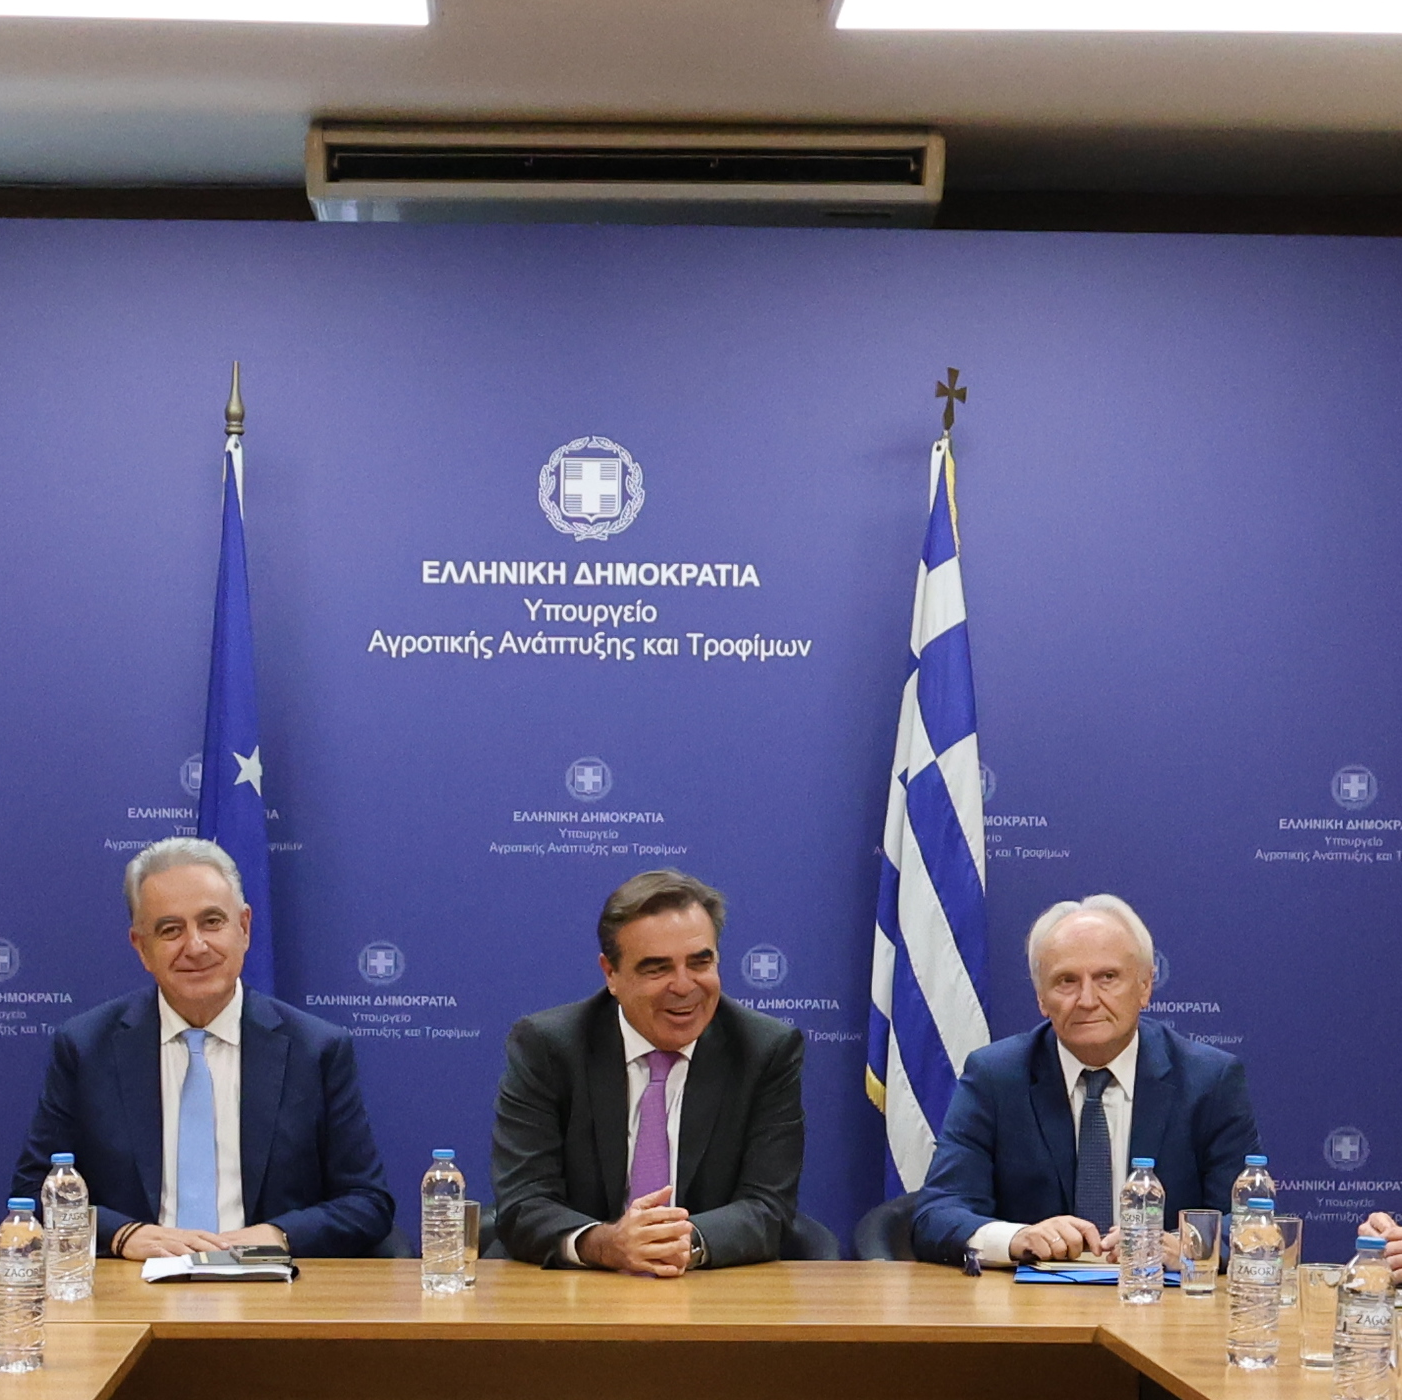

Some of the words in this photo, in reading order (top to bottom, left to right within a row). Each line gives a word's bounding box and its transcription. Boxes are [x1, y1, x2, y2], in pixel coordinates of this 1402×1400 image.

[422, 561, 566, 584] ΕΛΛΗΝΙΚΗ
[574, 563, 760, 587] ΔΗΜΟΚΡΑΤΙΑ
[524, 598, 657, 627] Υπουργείο
[368, 630, 493, 658] Αγροτικής
[499, 631, 635, 660] Ανάπτυξης
[643, 637, 678, 656] και
[686, 632, 812, 661] Τροφίμων
[127, 807, 193, 819] ΕΛΛΗΝΙΚΗ
[513, 810, 578, 823] ΕΛΛΗΝΙΚΗ
[581, 811, 664, 823] ΔΗΜΟΚΡΑΤΙΑ
[984, 815, 1048, 827] ΜΟΚΡΑΤΙΑ
[1279, 818, 1343, 830] ΕΛΛΗΝΙΚΗ
[558, 828, 619, 840] Υπουργείο
[1324, 835, 1383, 848] Υπουργείο
[489, 842, 545, 855] Αγροτικής
[547, 842, 609, 856] Ανάπτυξης
[612, 845, 628, 854] και
[632, 843, 687, 856] Τροφίμων
[995, 848, 1011, 858] και
[1014, 846, 1070, 860] Τροφίμων
[306, 994, 371, 1006] ΕΛΛΗΝΙΚΗ
[374, 995, 457, 1007] ΔΗΜΟΚΡΑΤΙΑ
[757, 998, 839, 1010] ΔΗΜΟΚΡΑΤΙΑ
[352, 1012, 412, 1025] Υπουργείο
[425, 1026, 480, 1040] Τροφίμων
[807, 1029, 863, 1043] Τροφίμων
[1274, 1180, 1335, 1191] ΕΛΛΗΝΙΚΗ
[1237, 1265, 1276, 1276] ZAGORI
